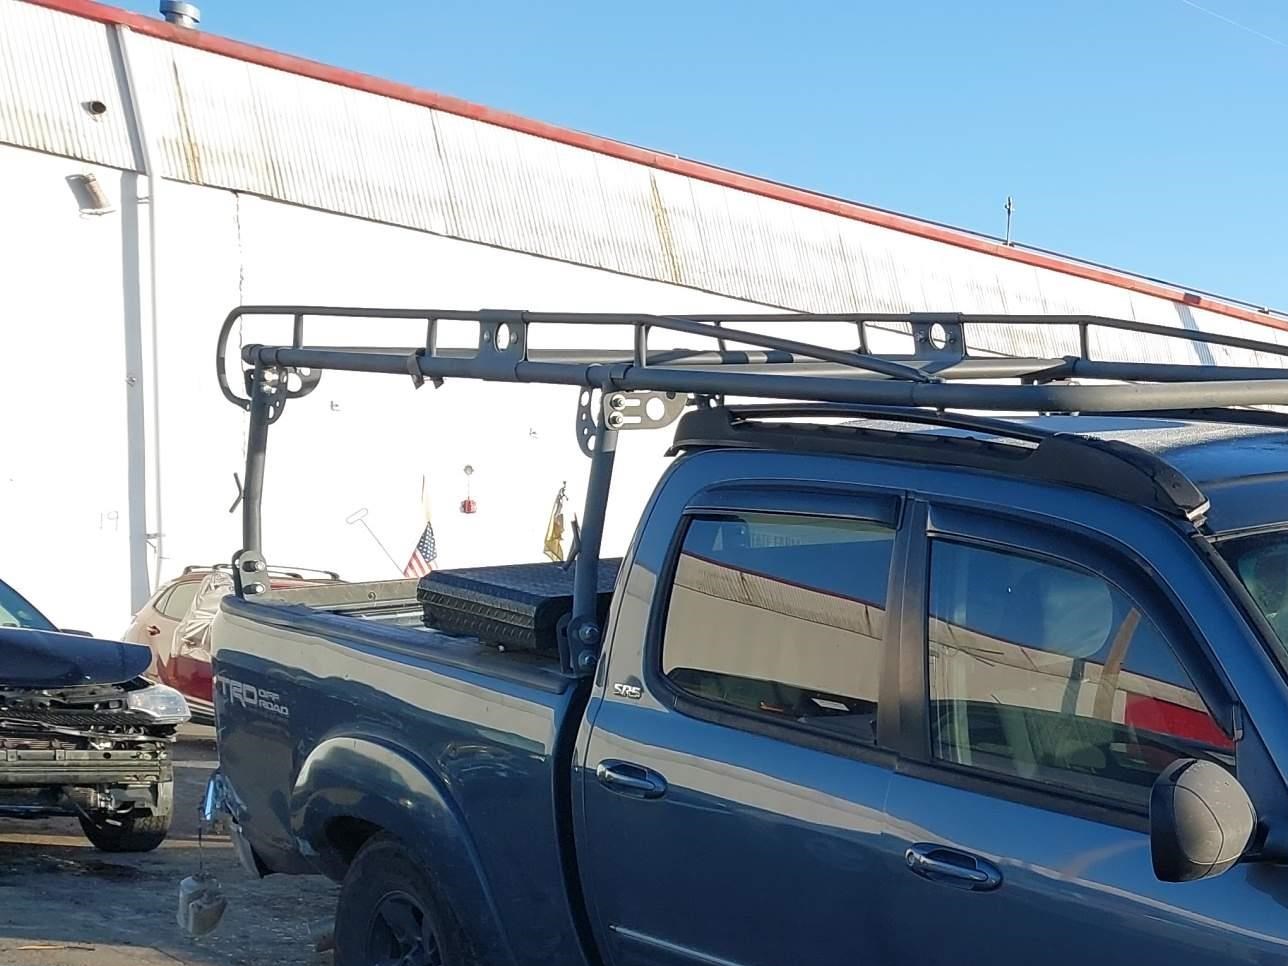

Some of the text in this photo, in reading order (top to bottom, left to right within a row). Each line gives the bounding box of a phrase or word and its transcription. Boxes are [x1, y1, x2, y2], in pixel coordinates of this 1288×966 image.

[215, 675, 258, 708] TRD
[258, 689, 280, 701] OFF
[613, 683, 641, 698] SR5
[259, 699, 289, 715] ROAD
